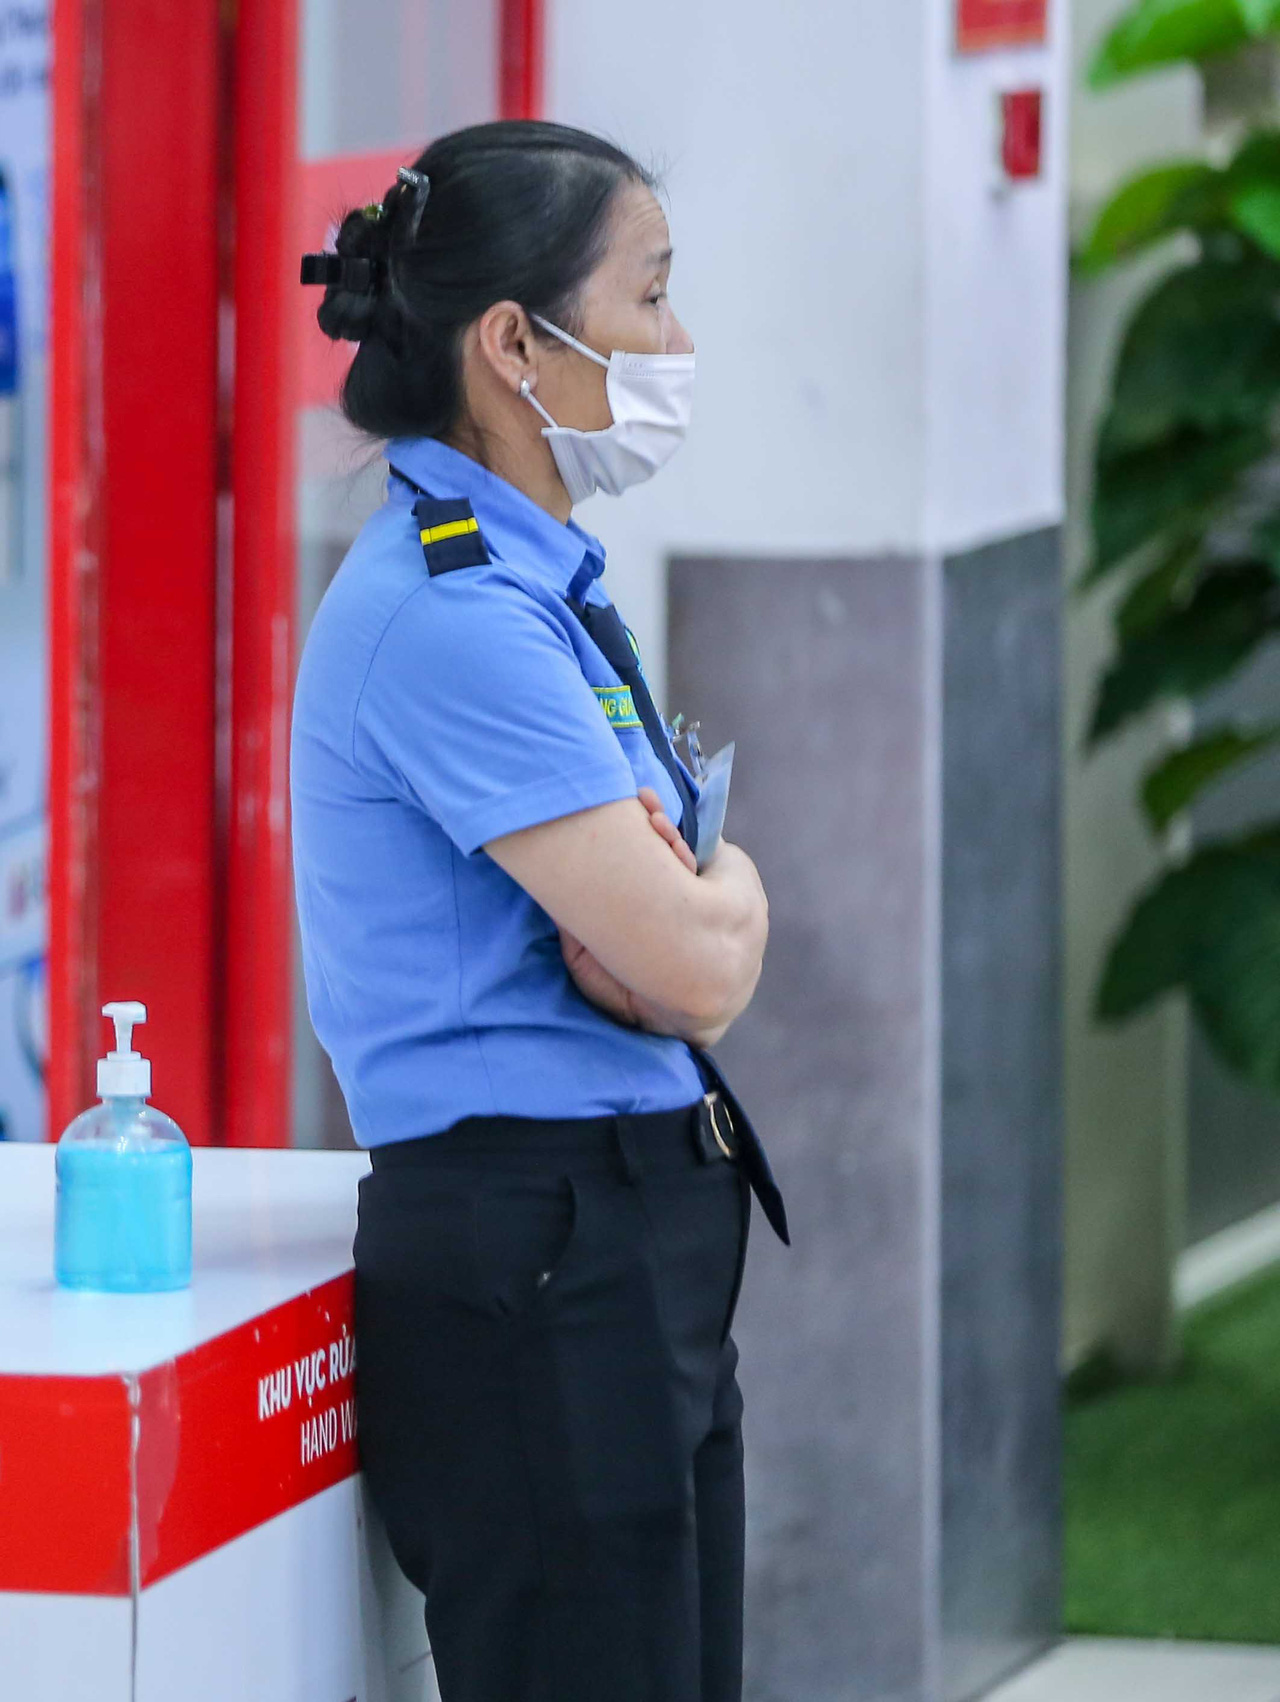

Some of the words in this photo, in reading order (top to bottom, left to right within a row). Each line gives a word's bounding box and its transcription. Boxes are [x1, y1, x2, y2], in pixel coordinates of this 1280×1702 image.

[258, 1365, 291, 1421] KHU
[294, 1348, 326, 1408] VỰC
[301, 1407, 337, 1467] HAND
